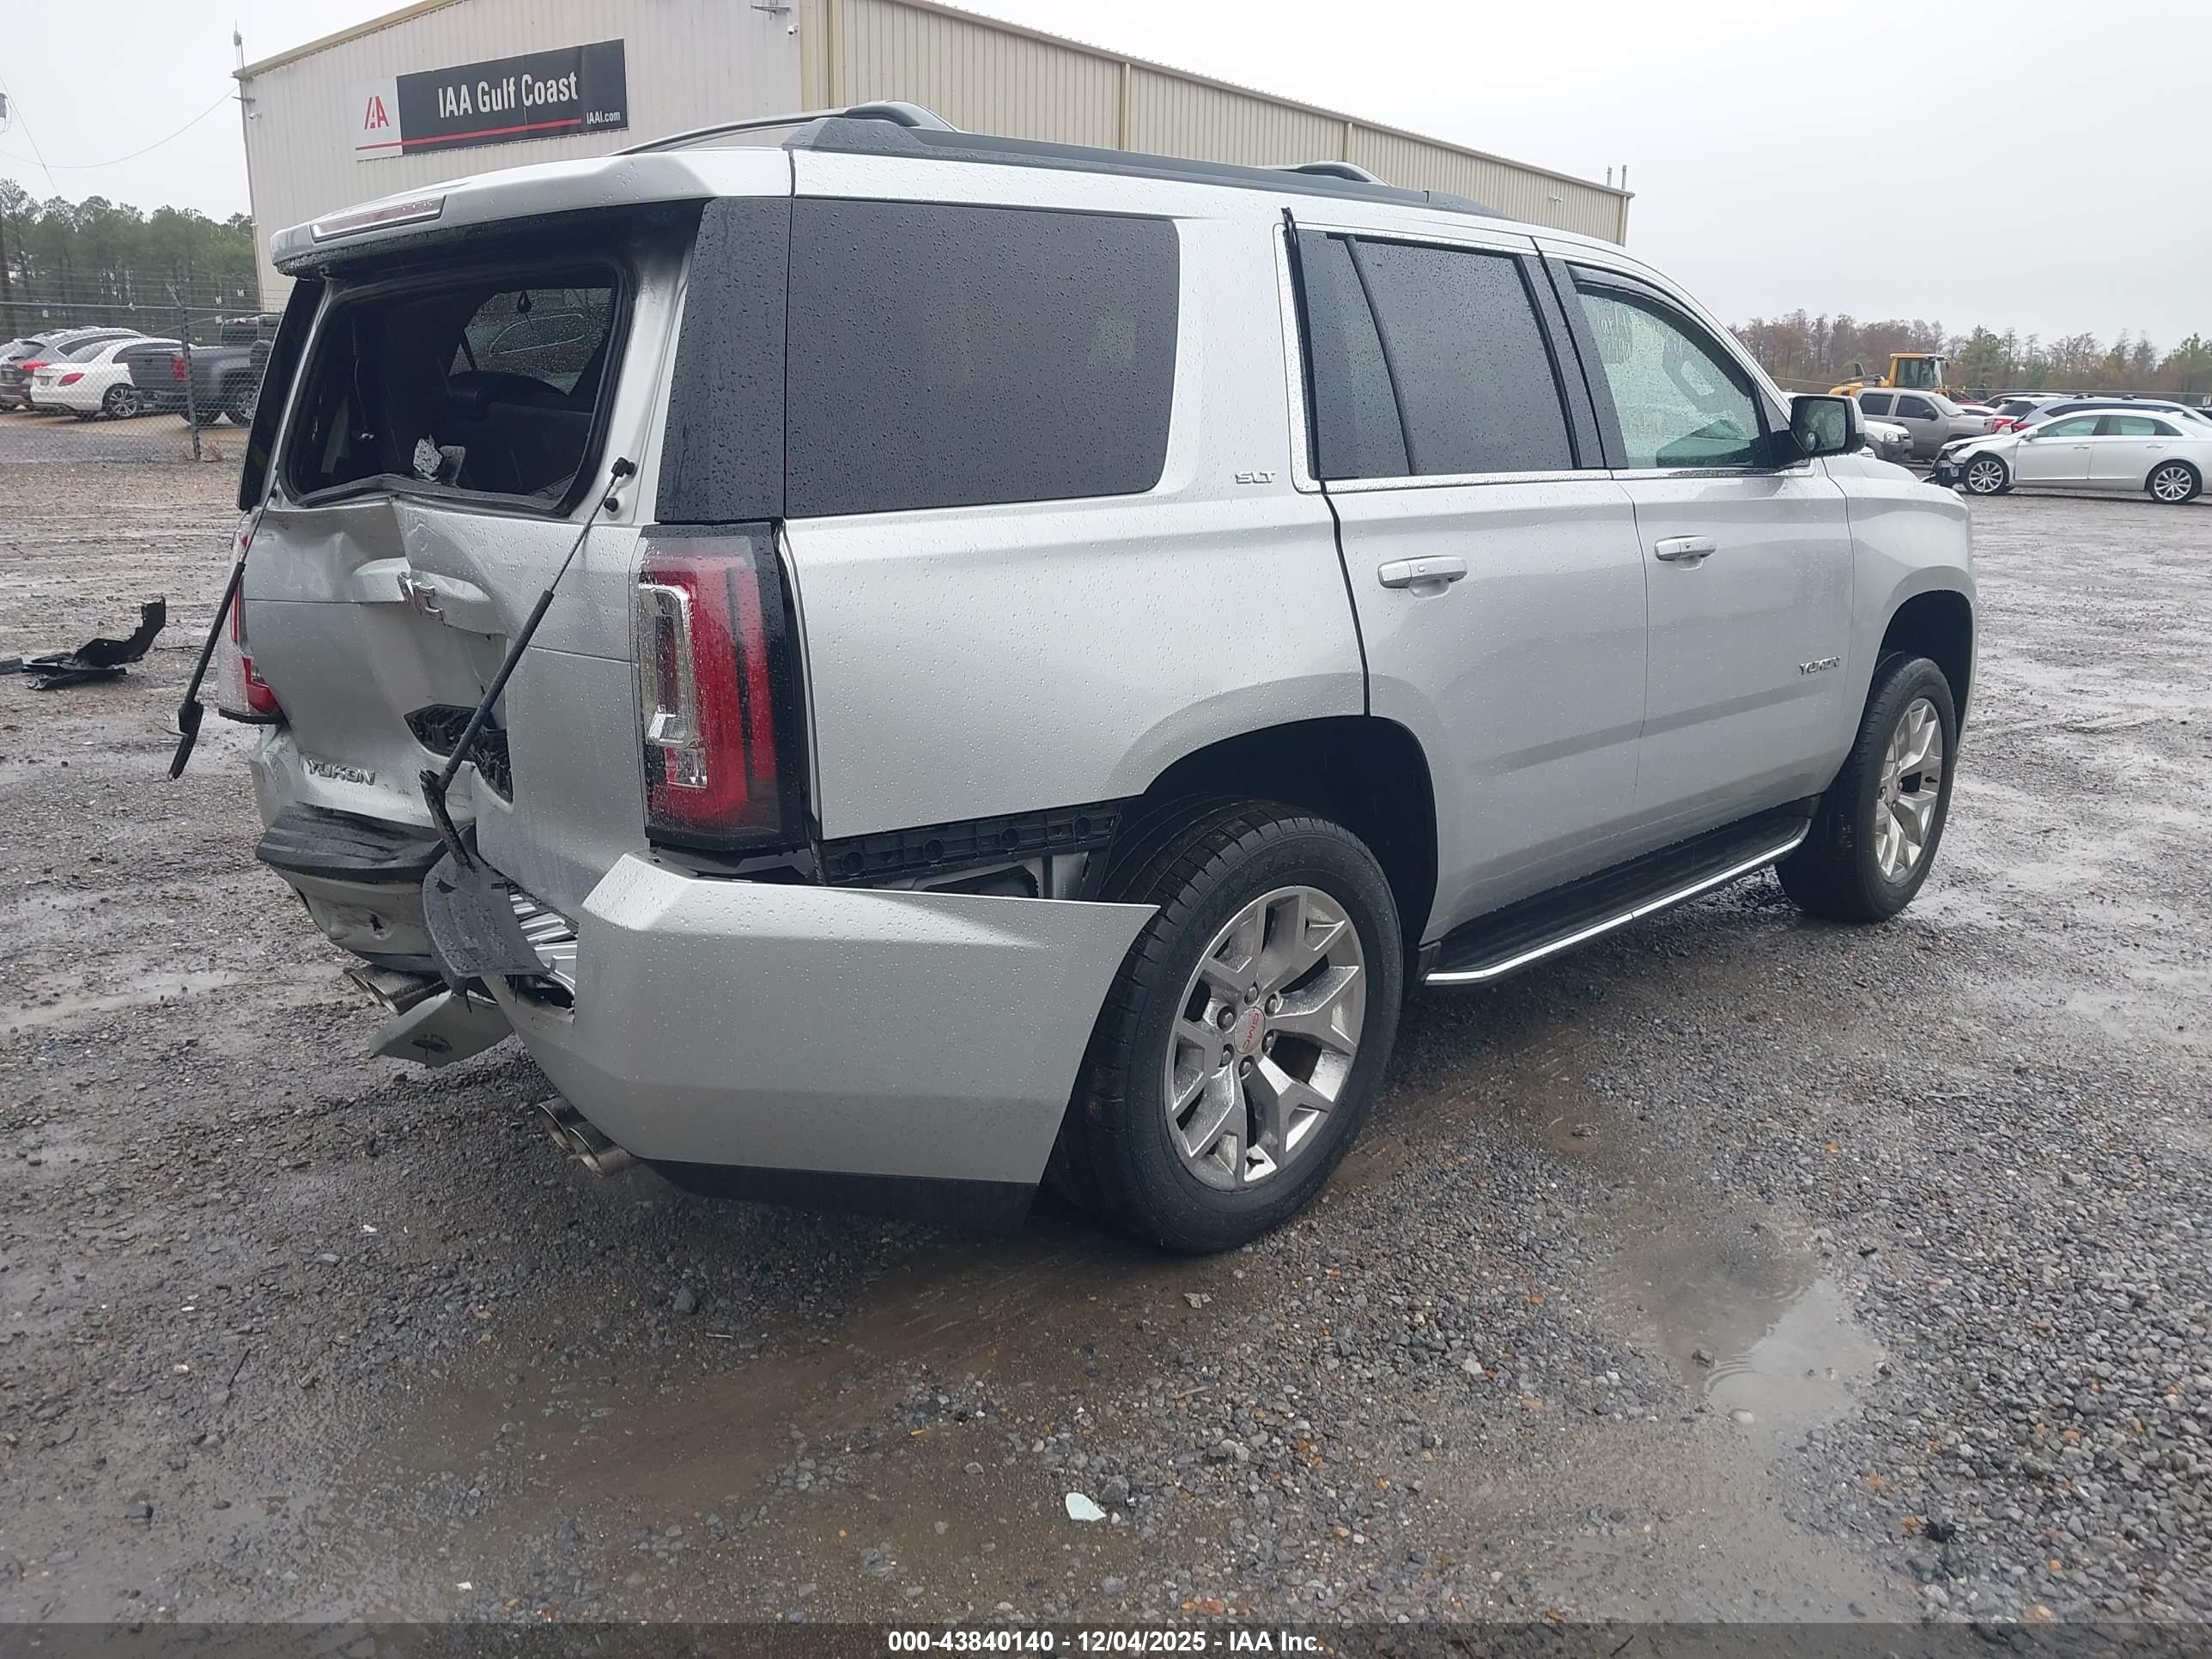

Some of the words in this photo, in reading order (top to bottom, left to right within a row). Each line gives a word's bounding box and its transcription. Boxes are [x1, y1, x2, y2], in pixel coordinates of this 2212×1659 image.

[438, 84, 472, 118] IAA
[477, 76, 515, 112] Gulf
[521, 71, 578, 106] Coast
[586, 111, 621, 124] IAAI.com
[1235, 471, 1276, 484] SLT
[1242, 1012, 1260, 1049] GMC
